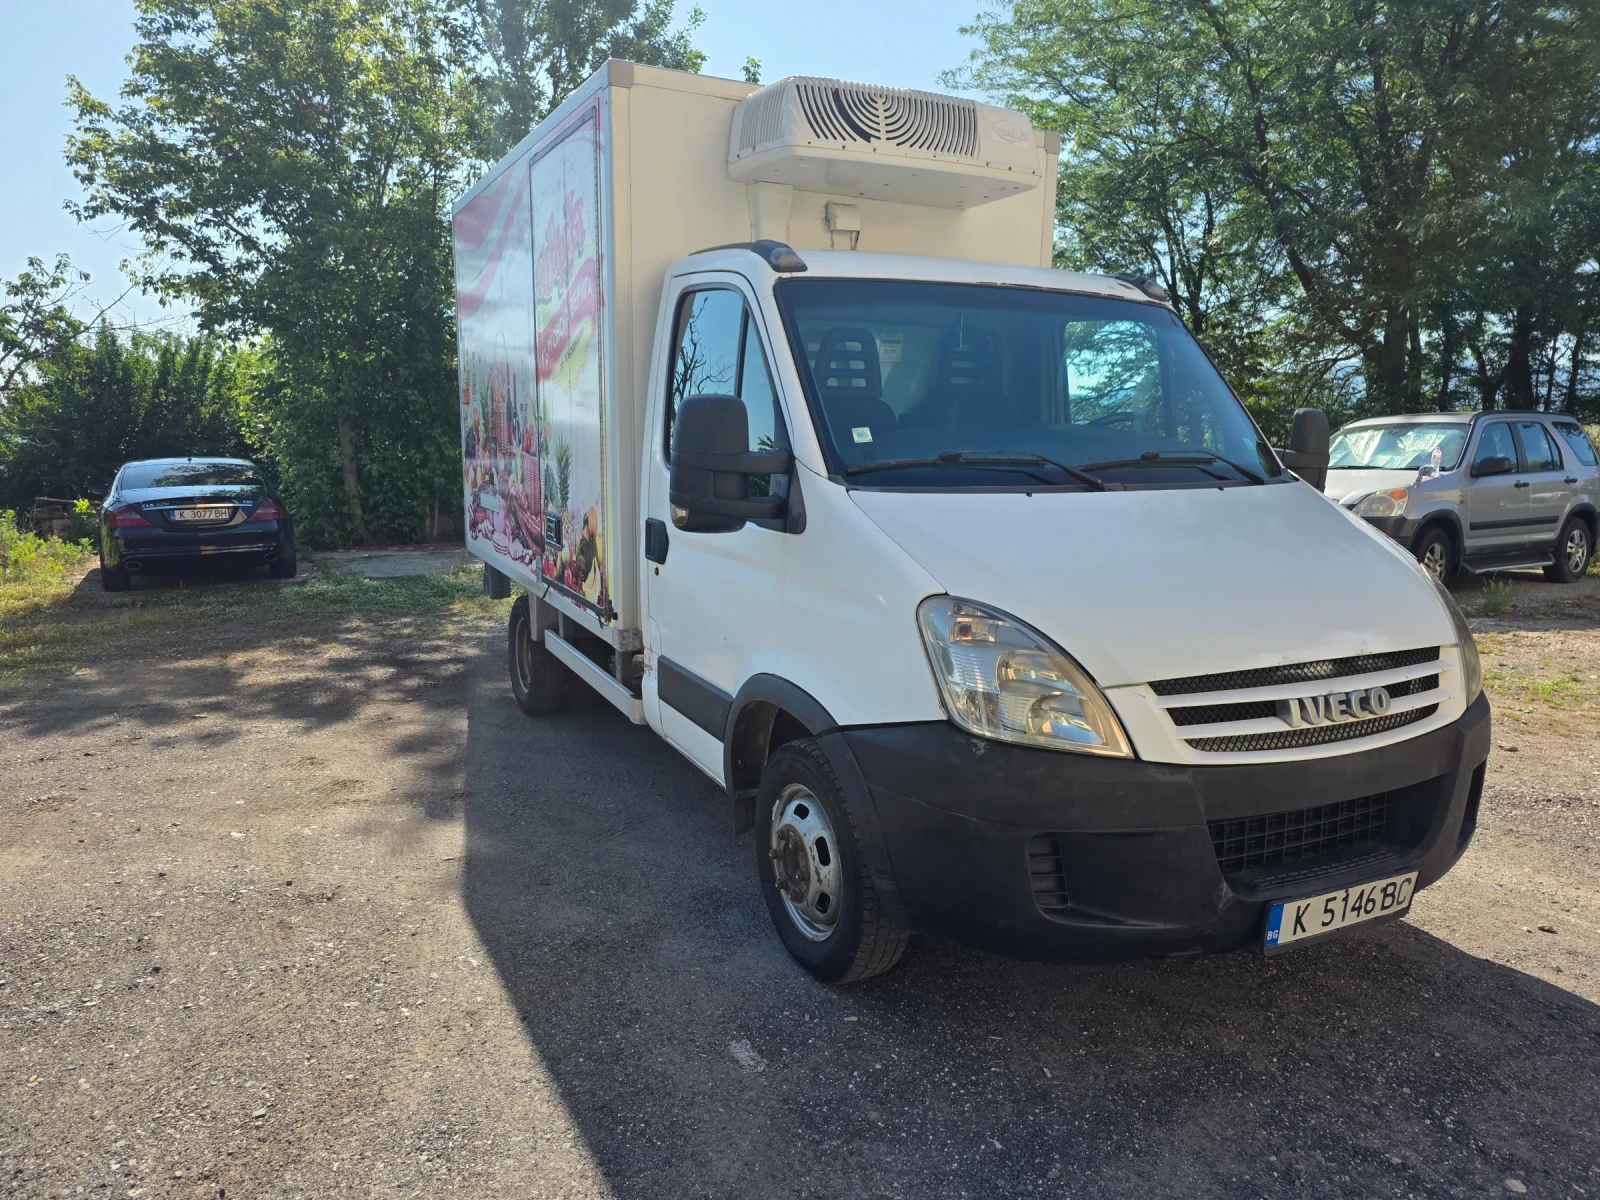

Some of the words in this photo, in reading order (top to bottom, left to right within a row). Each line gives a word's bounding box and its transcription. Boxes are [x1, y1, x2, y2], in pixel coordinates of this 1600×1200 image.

[179, 511, 186, 520] K
[190, 509, 212, 519] 3077
[214, 508, 227, 518] BH
[1286, 686, 1392, 728] IVECO
[1292, 902, 1311, 936] K
[1321, 886, 1377, 927] 5146
[1380, 877, 1413, 911] BC
[1266, 928, 1279, 941] BG
